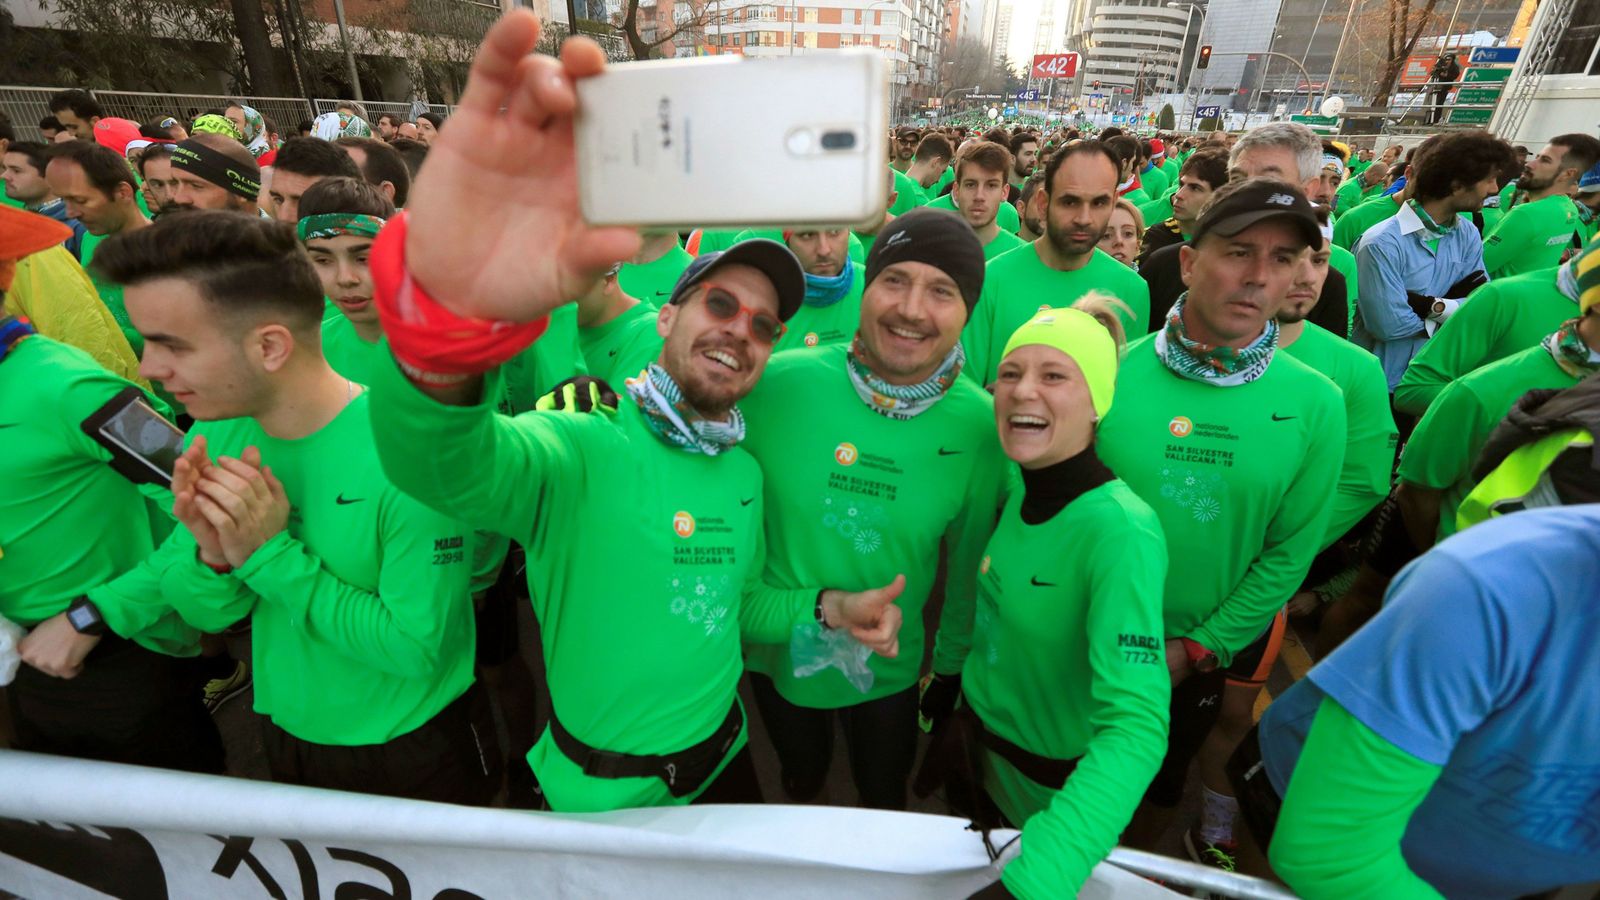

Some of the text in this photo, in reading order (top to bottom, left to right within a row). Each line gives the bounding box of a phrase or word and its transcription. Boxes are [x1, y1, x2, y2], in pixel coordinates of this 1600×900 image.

[1164, 452, 1217, 465] VALLECANA
[1166, 444, 1234, 460] SAN SILVESTRE
[827, 480, 880, 498] VALLECANA
[829, 472, 898, 494] SAN SILVESTRE
[674, 546, 735, 555] SAN SILVESTRE
[673, 556, 723, 565] VALLECANA
